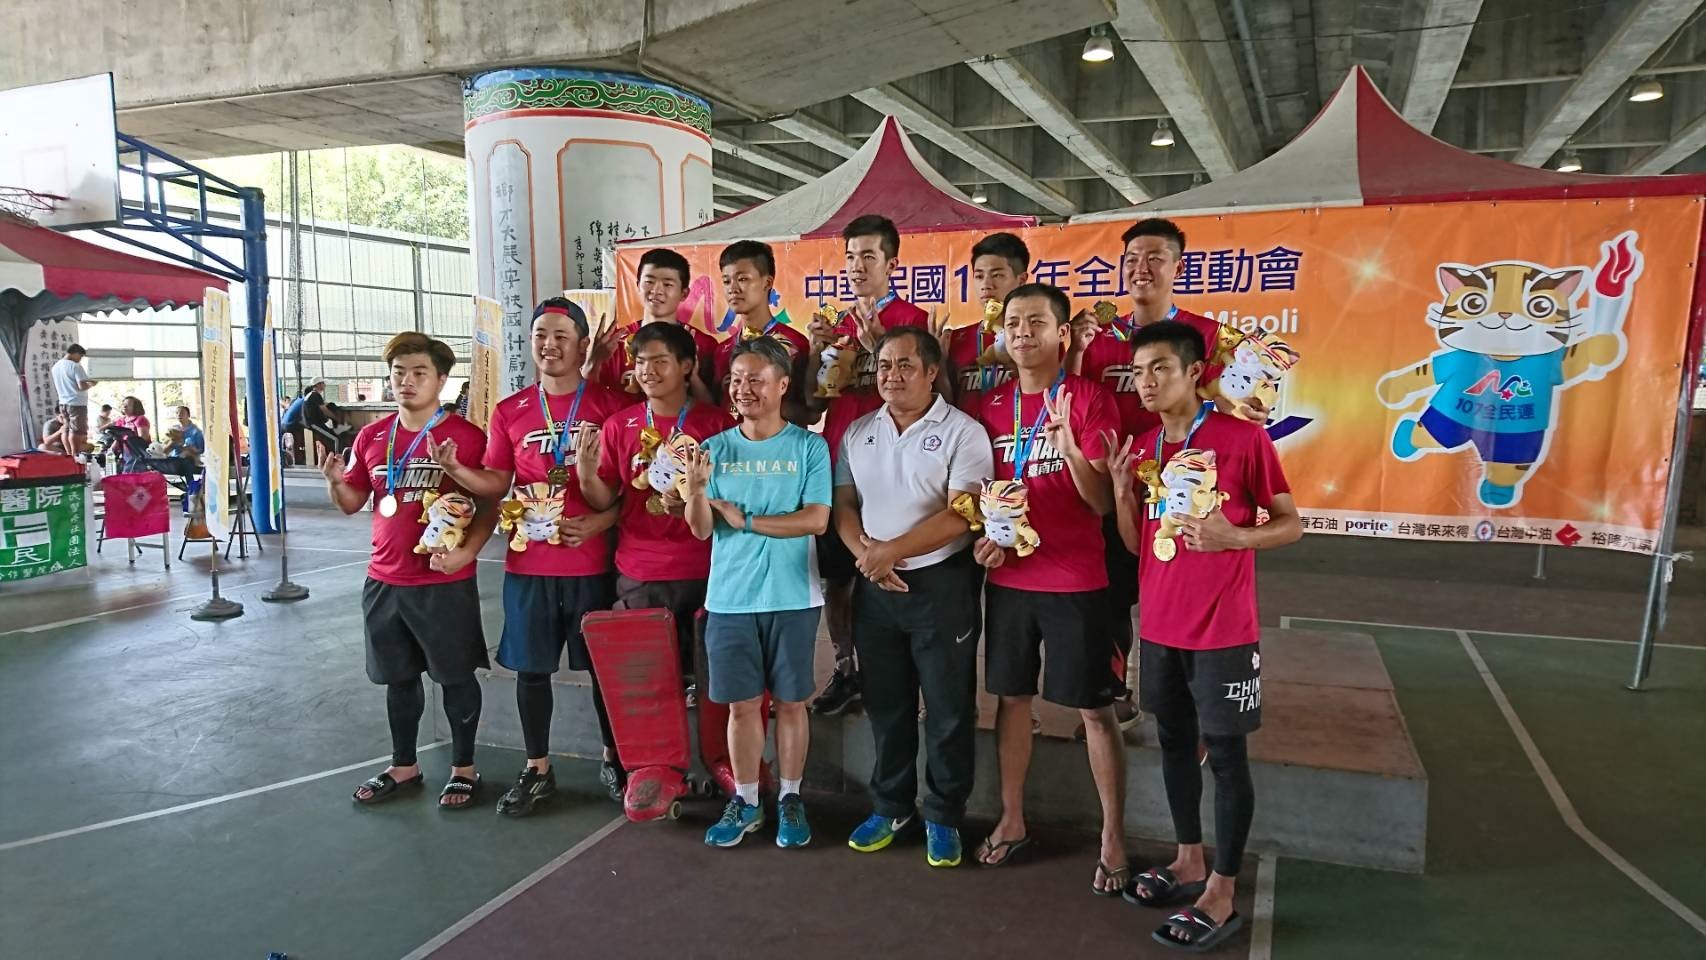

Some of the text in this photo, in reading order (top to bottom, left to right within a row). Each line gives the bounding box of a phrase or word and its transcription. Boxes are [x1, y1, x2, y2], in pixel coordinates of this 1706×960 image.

[1456, 398, 1535, 420] 107全民運
[1221, 675, 1261, 698] CHIN
